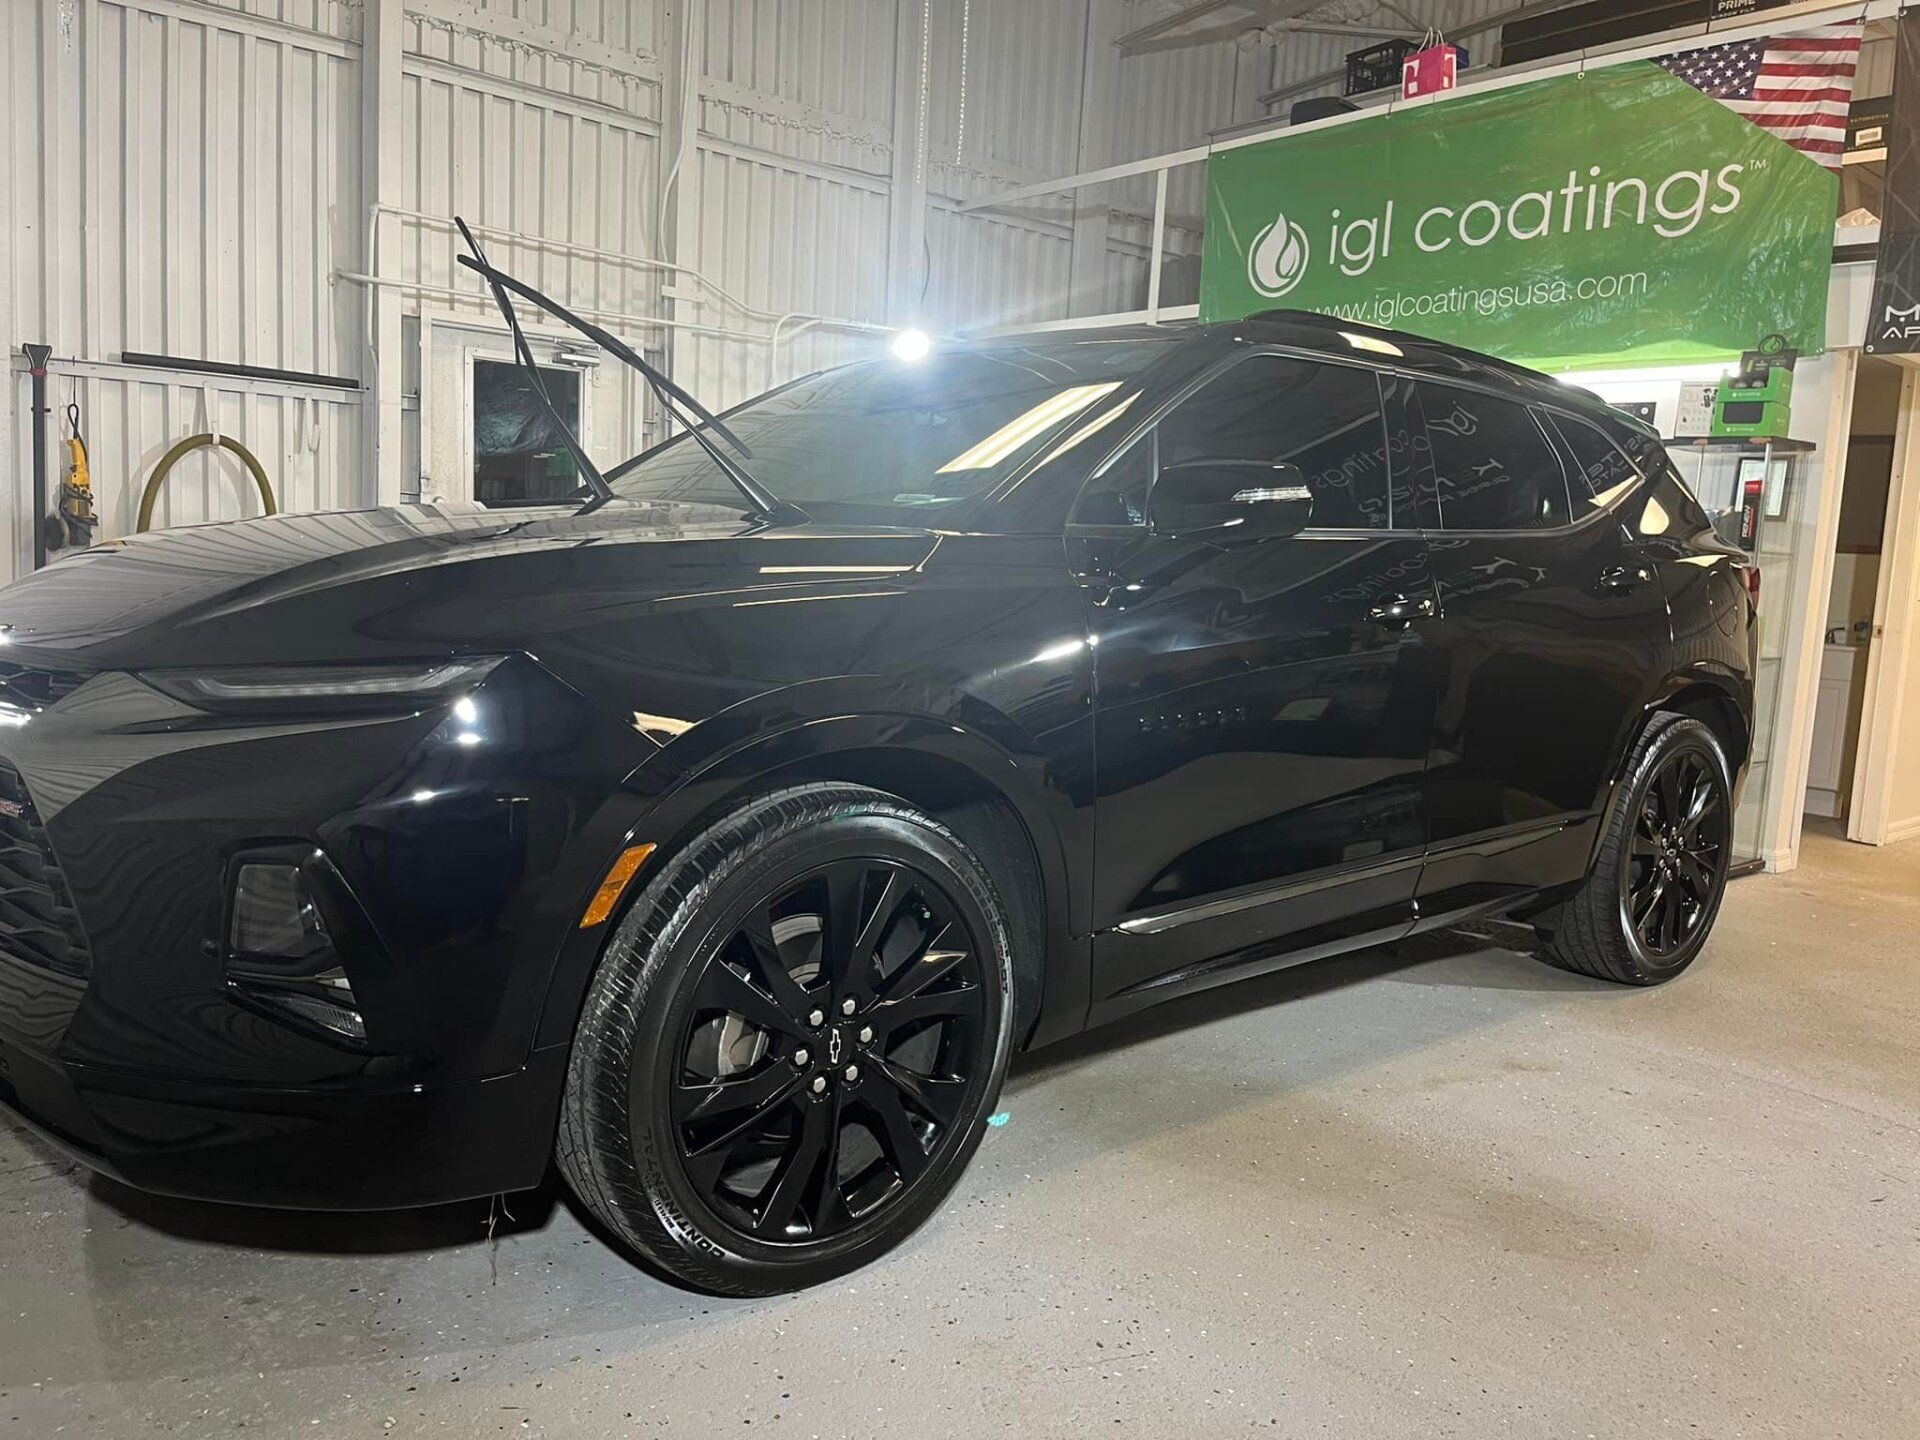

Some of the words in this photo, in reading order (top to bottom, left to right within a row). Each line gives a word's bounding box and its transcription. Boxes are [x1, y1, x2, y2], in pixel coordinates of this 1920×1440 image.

[1329, 200, 1394, 277] igl
[1414, 163, 1745, 253] coatings
[1306, 272, 1647, 325] ww.iglcoatingsusa.com
